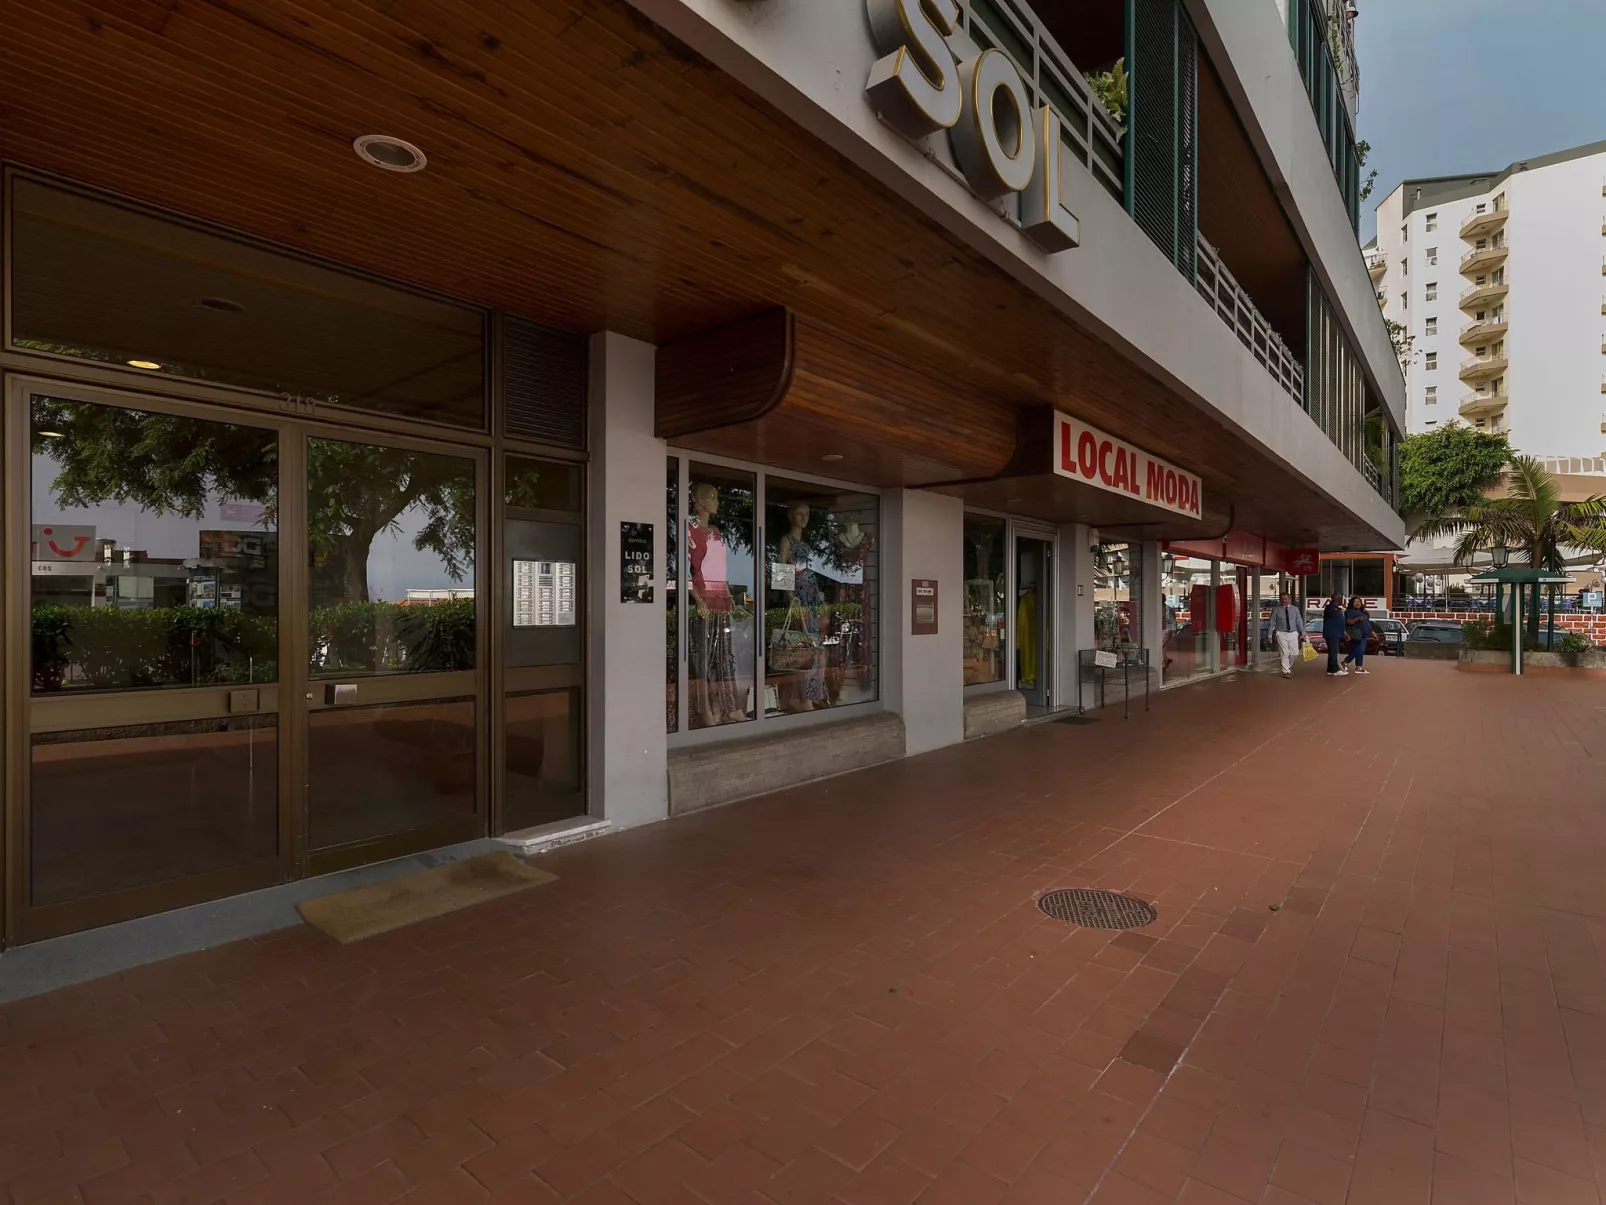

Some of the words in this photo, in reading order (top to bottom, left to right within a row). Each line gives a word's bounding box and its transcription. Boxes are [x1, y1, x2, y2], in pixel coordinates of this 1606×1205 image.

[866, 0, 1080, 254] SOL
[1061, 420, 1140, 495] LOCAL
[1146, 460, 1200, 515] MODA
[624, 550, 650, 561] LIDO
[627, 565, 648, 574] SOL
[1587, 592, 1597, 603] P
